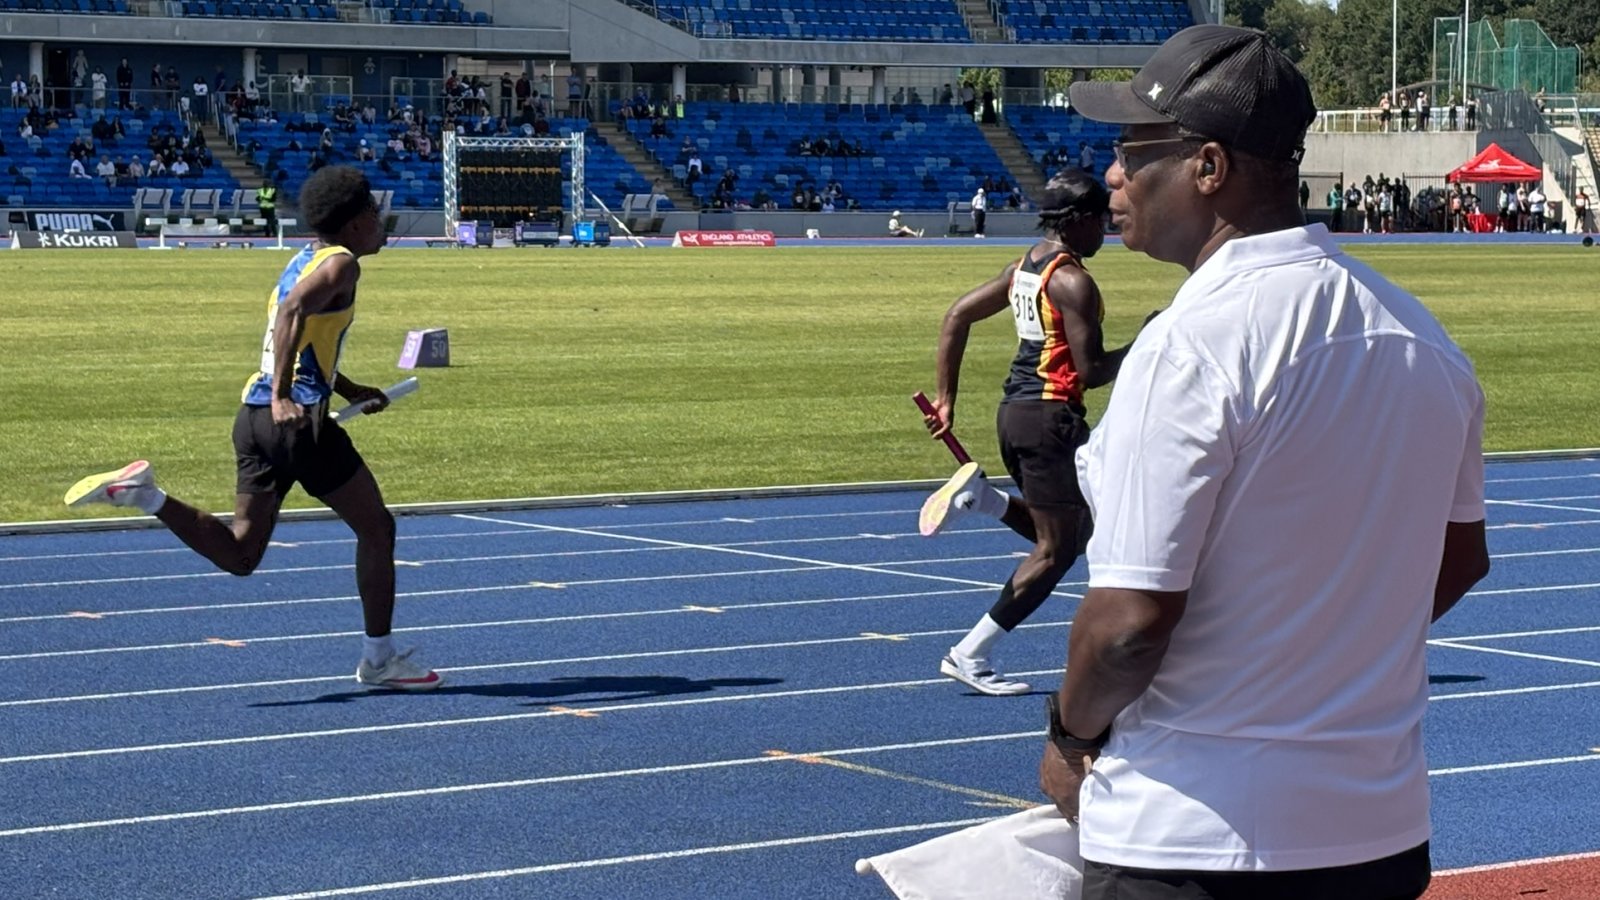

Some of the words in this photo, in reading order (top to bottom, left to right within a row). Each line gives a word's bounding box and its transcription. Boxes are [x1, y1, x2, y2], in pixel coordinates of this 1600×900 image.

[35, 213, 93, 230] PUMA
[54, 234, 118, 247] KUKRI
[702, 233, 734, 241] ENGLAND
[737, 233, 771, 241] ATHLETICS
[431, 340, 446, 358] 50
